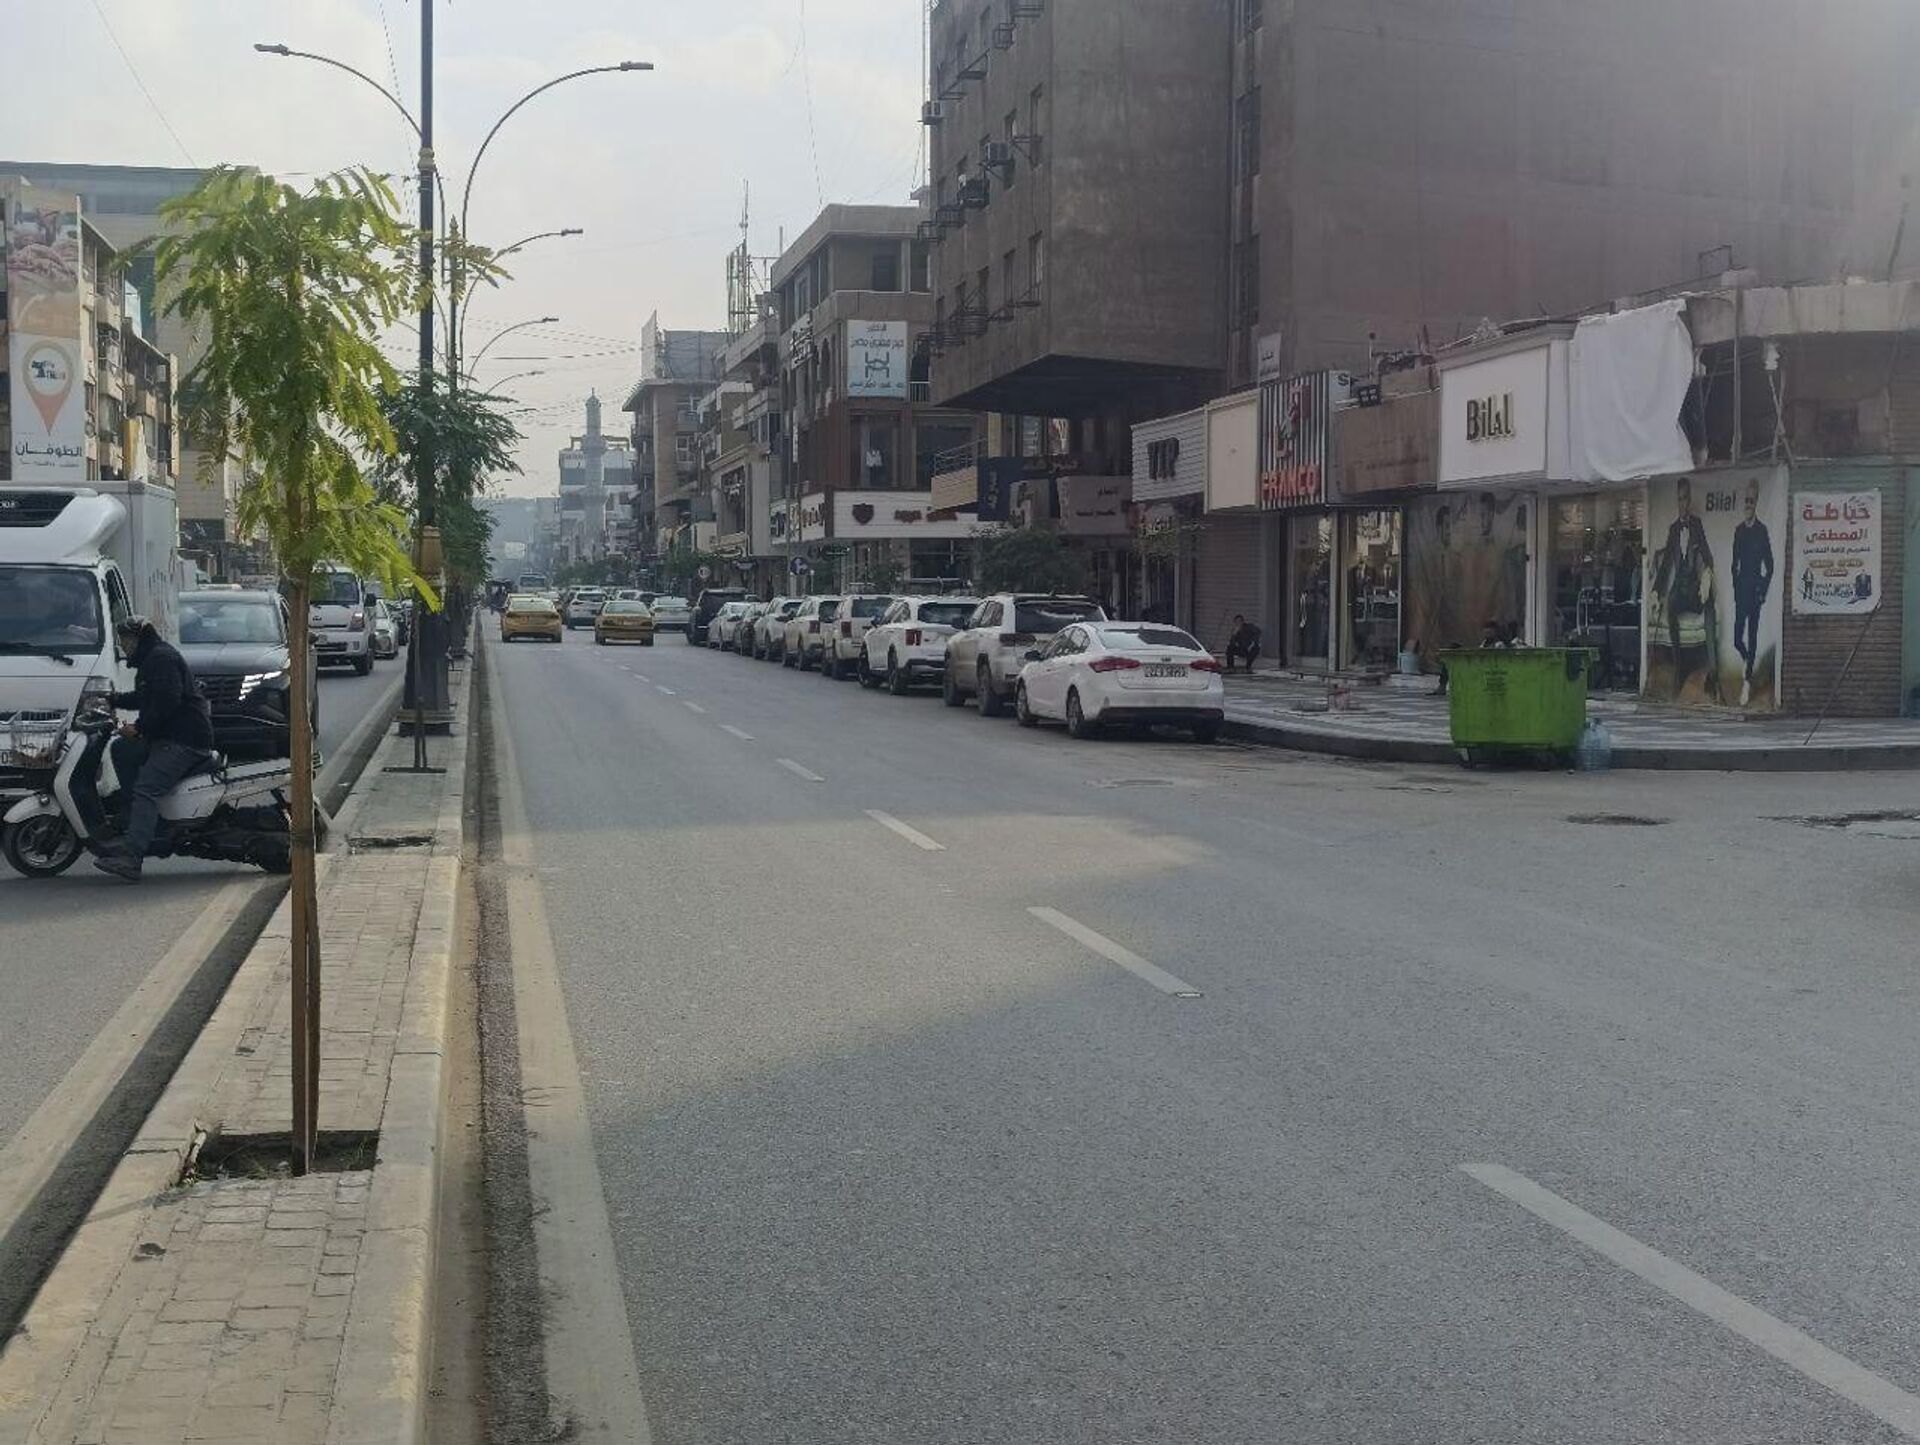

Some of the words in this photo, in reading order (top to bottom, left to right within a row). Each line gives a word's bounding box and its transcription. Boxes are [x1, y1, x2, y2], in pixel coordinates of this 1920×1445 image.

[1466, 393, 1512, 441] Bilal
[15, 442, 83, 458] الطوفان
[1261, 466, 1317, 498] FRANCO
[1706, 491, 1736, 511] Bilal
